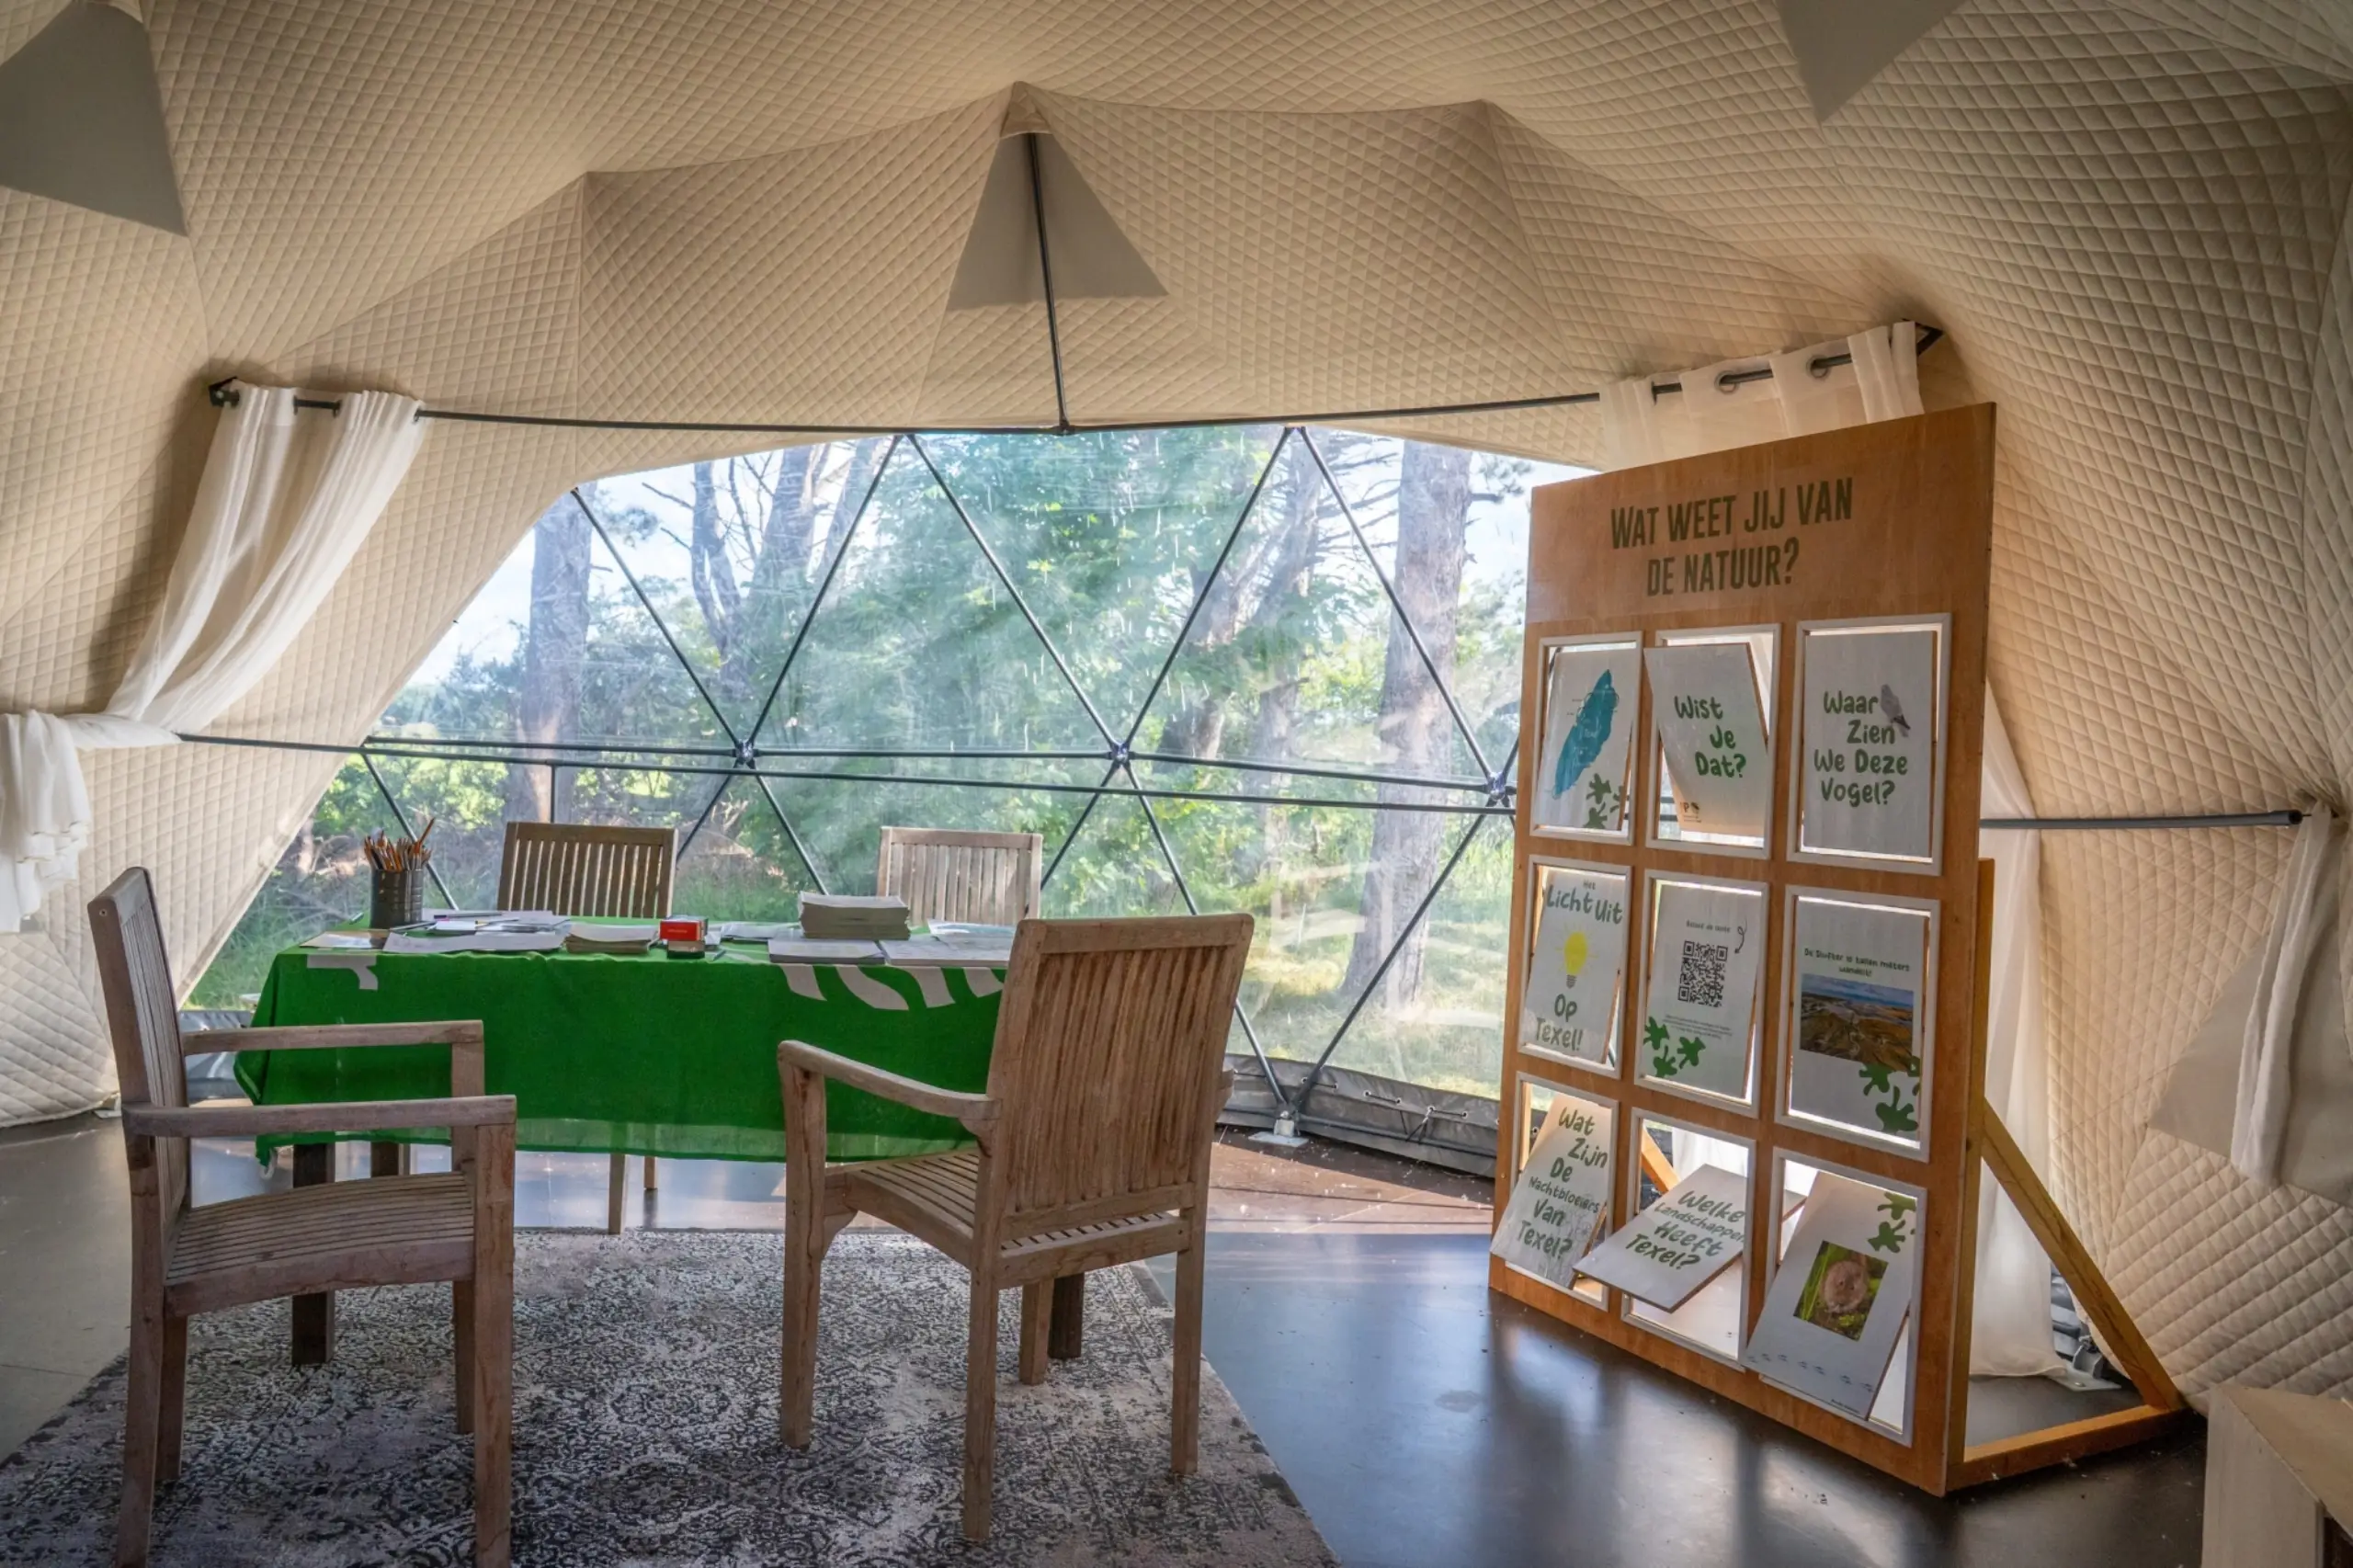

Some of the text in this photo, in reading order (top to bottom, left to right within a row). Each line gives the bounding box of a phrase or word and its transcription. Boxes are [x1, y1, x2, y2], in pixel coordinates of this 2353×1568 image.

[1610, 477, 1852, 549] WAT WEET JIJ VAN
[1646, 536, 1799, 597] DE NATUUR?
[1674, 696, 1723, 720] Wist
[1824, 690, 1879, 714] Waar
[1710, 725, 1736, 749] Je
[1847, 720, 1895, 744] Zien
[1695, 752, 1746, 778] Dat?
[1813, 749, 1908, 775] We Deze
[1821, 778, 1895, 808] Vogel?
[1546, 885, 1623, 925] Licht Uit
[1554, 994, 1577, 1023] Op
[1536, 1017, 1583, 1051] Texel!
[1558, 1106, 1595, 1136] Wat
[1568, 1138, 1608, 1168] Zijn
[1550, 1157, 1573, 1183] De
[1529, 1176, 1600, 1213] Nachtbloeiers
[1677, 1190, 1745, 1222] Welke
[1533, 1199, 1566, 1227] Van
[1518, 1220, 1573, 1259] Texel?
[1625, 1233, 1700, 1269] Texel?
[1654, 1221, 1723, 1256] Heeft
